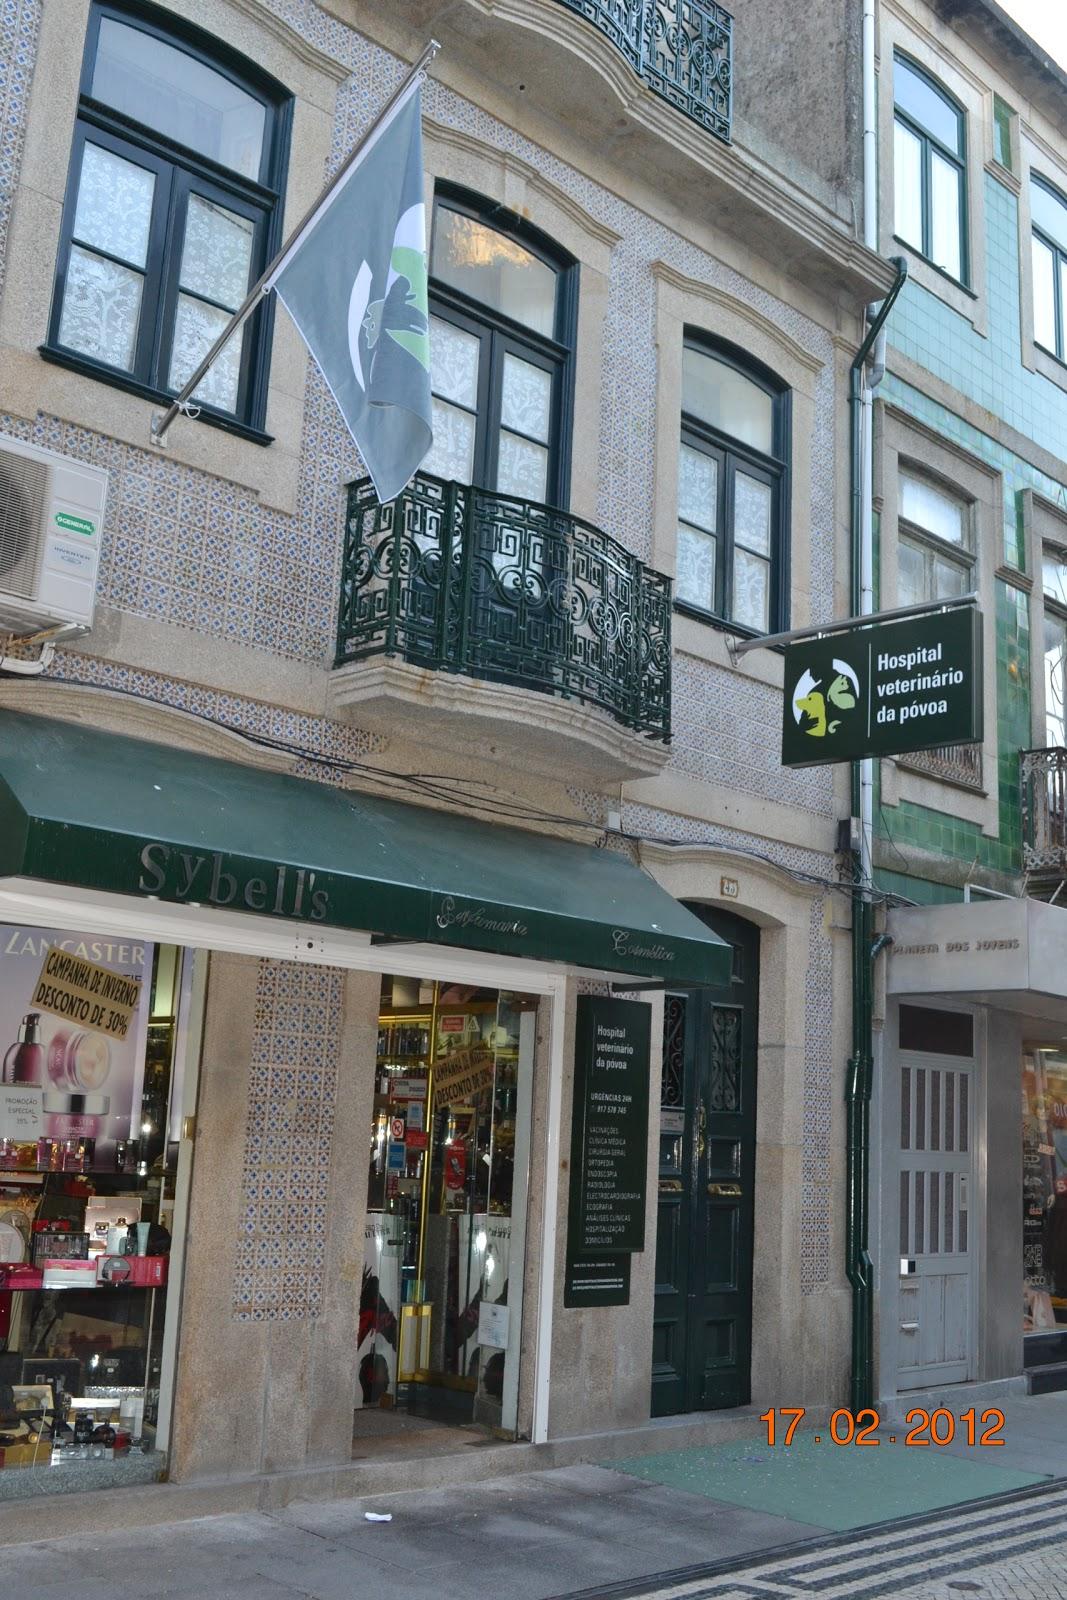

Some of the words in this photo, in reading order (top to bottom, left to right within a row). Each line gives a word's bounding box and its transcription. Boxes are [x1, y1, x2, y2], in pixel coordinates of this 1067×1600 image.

[877, 643, 942, 671] Hospital
[877, 667, 963, 697] veterinário
[877, 705, 895, 723] da
[899, 700, 947, 724] póvoa
[138, 843, 329, 920] Sybell's
[4, 932, 145, 965] LANCASTER
[945, 942, 970, 953] DOS
[975, 938, 1020, 951] JOVENS
[46, 952, 89, 990] CAMPANHA
[89, 970, 103, 994] DE
[101, 975, 138, 1008] INVERNO
[35, 983, 90, 1021] DESCONTO
[90, 1004, 105, 1026] DE
[105, 1011, 129, 1036] 30%
[597, 1025, 626, 1039] Hospital
[596, 1042, 634, 1055] veterinário
[596, 1056, 605, 1067] da
[606, 1058, 627, 1070] póvoa
